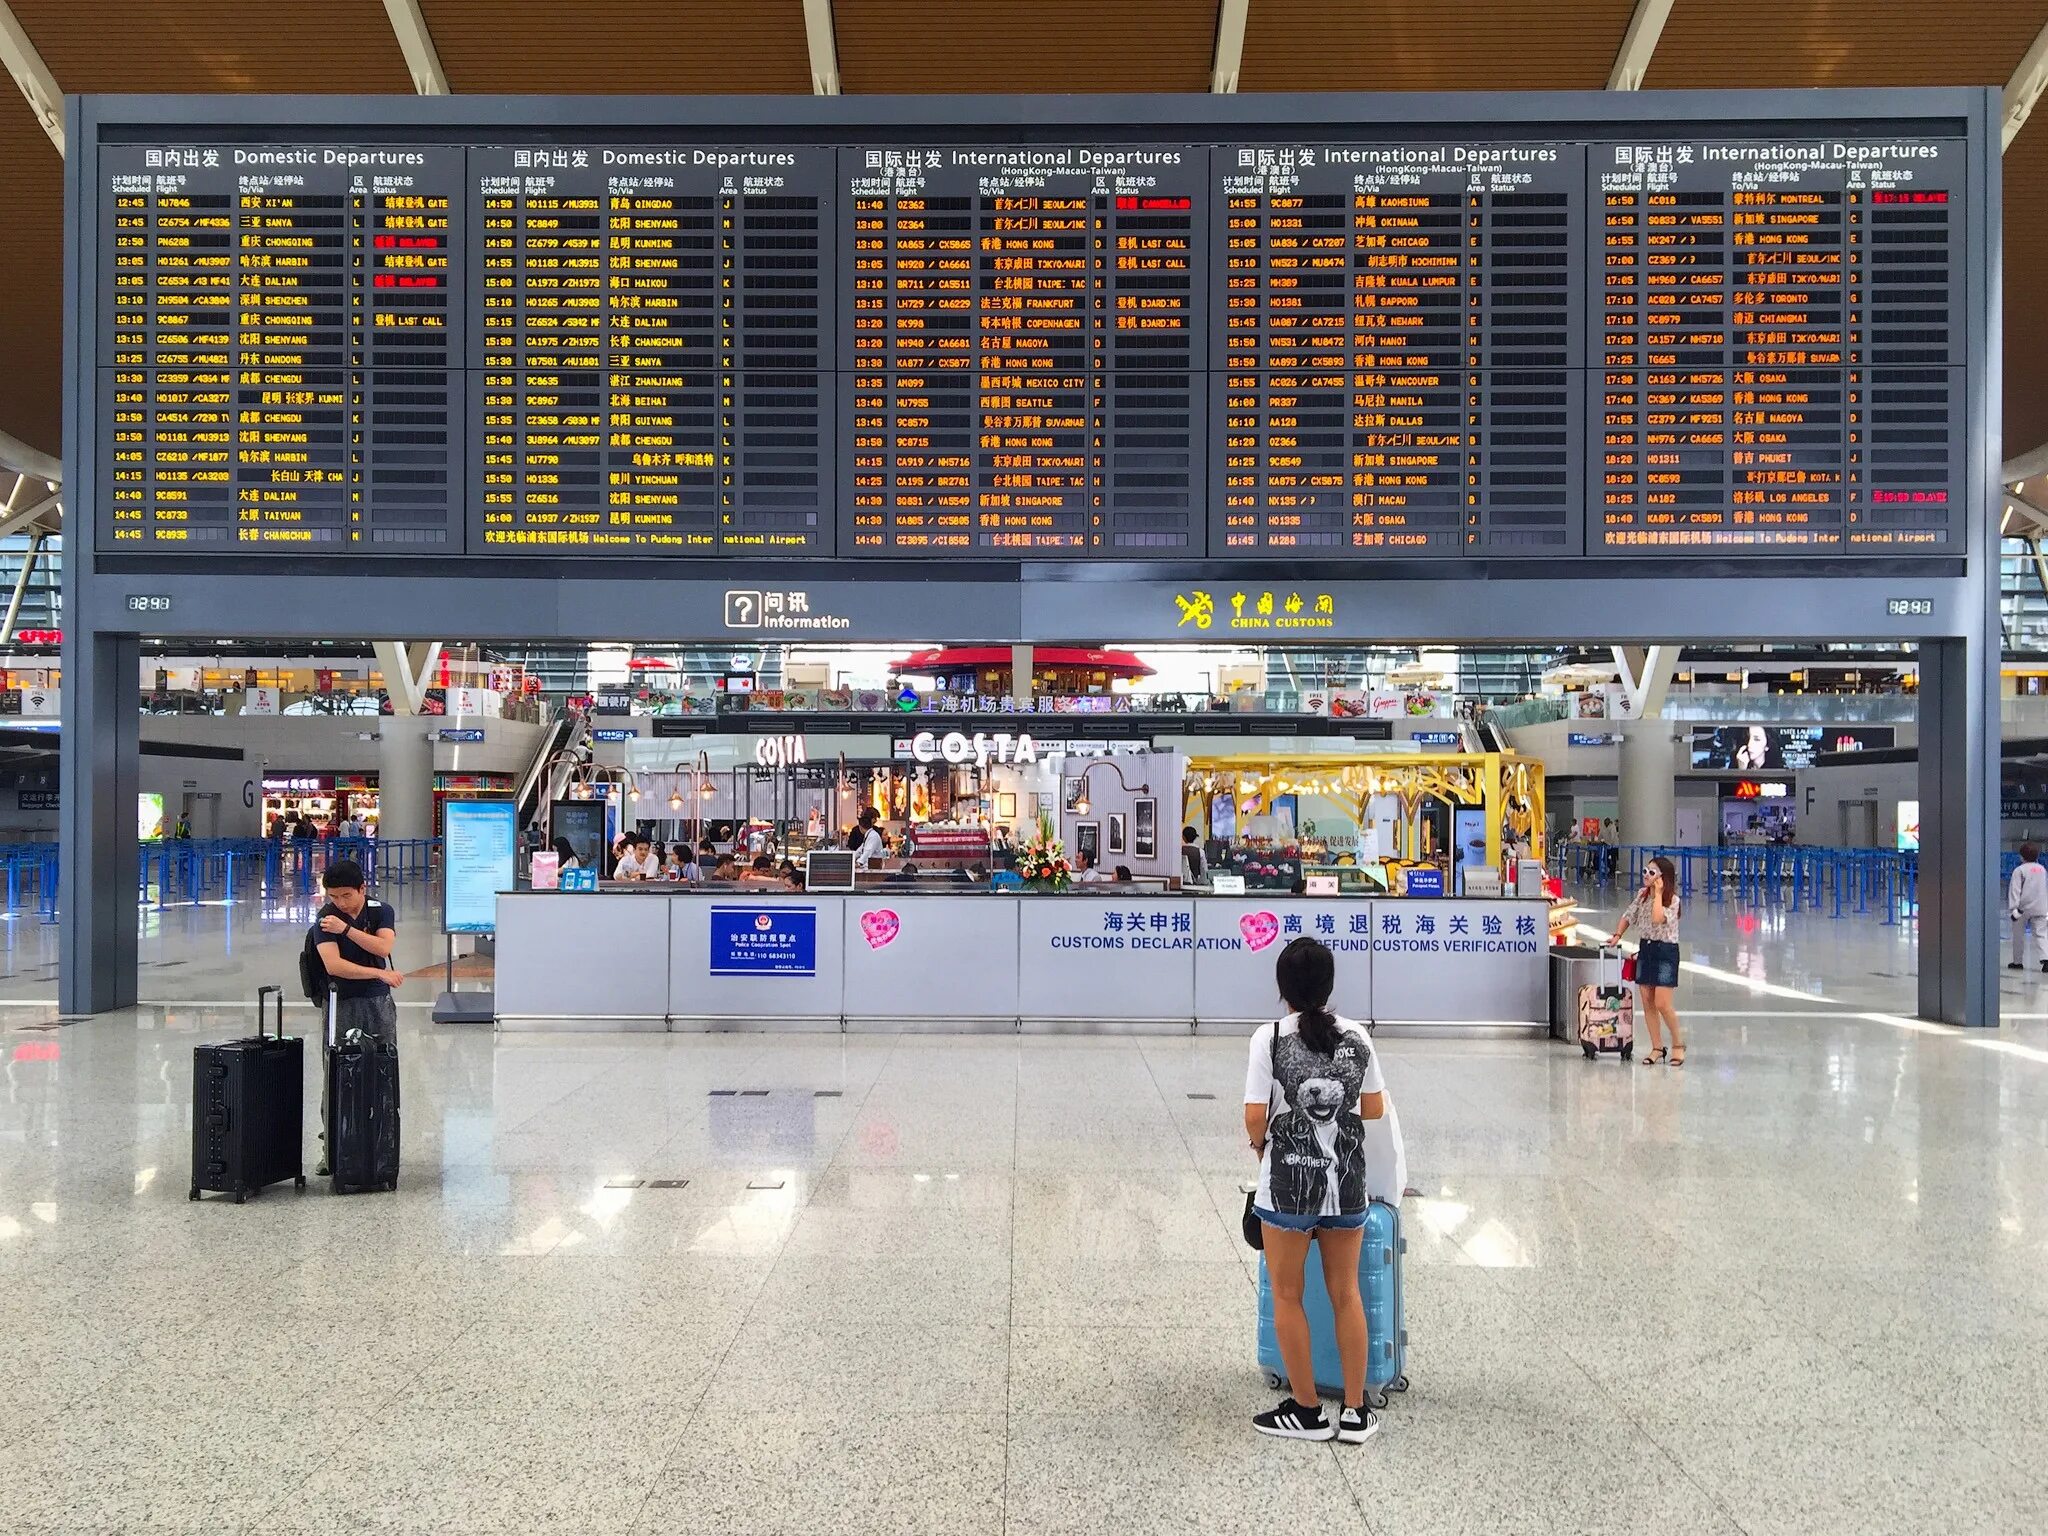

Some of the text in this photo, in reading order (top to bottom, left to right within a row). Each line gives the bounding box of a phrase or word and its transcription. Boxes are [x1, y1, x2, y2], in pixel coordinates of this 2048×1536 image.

[146, 149, 423, 167] 国内出发 Domestic Departures
[515, 150, 794, 168] 国内出发 Domestic Departures
[866, 149, 1180, 169] 国际出发 International Departures
[1239, 147, 1556, 167] 国际出发 International Departures
[1616, 144, 1937, 164] 国际出发 International Departures
[999, 166, 1127, 176] (HongKong-Macau-Taiwan)
[1374, 164, 1504, 174] (HongKong-Macau-Taiwan)
[1752, 160, 1885, 171] (HongKong-Macau-Taiwan)
[111, 175, 152, 186] 计划时间
[156, 175, 186, 186] 航班号
[239, 175, 304, 186] 终点站/经停站
[373, 176, 414, 186] 航班状态
[480, 176, 520, 187] 计划时间
[525, 176, 555, 187] 航班号
[608, 176, 674, 188] 终点站/经停站
[743, 176, 784, 187] 航班状态
[850, 177, 890, 188] 计划时间
[895, 177, 926, 188] 航班号
[979, 177, 1045, 187] 终点站/经停站
[1115, 176, 1156, 187] 航班状态
[1223, 175, 1264, 186] 计划时间
[1269, 175, 1300, 186] 航班号
[1354, 174, 1420, 185] 终点站/经停站
[1491, 173, 1532, 184] 航班状态
[1601, 173, 1642, 183] 计划时间
[1647, 173, 1678, 183] 航班号
[1732, 172, 1799, 183] 终点站/经停站
[1871, 170, 1913, 181] 航班状态
[111, 185, 397, 194] Scheduled Flight To/Via Area Status
[480, 187, 767, 196] Scheduled Flight To/Via Area Status
[851, 186, 1140, 196] Scheduled Flight To/Via Area Status
[1223, 184, 1515, 195] Scheduled Flight To/Via Area Status
[1601, 181, 1896, 192] Scheduled Flight To/Via Area Status
[118, 199, 144, 207] 12:45
[241, 196, 261, 208] 西安
[266, 199, 292, 207] XI'AN
[1607, 196, 1633, 205] 16:50
[1781, 195, 1823, 203] MONTREAL
[486, 219, 512, 228] 14:50
[610, 217, 630, 229] 沈阳
[635, 220, 678, 228] SHENYANG
[1771, 295, 1808, 303] TORONTO
[117, 316, 143, 324] 13:10
[241, 314, 260, 325] 重庆
[265, 316, 312, 325] CHONGQING
[376, 314, 395, 326] 登机
[423, 317, 442, 326] CALL
[857, 319, 883, 328] 13:20
[981, 317, 1021, 329] 哥本哈根
[1027, 320, 1079, 328] COPENHAGEN
[1229, 418, 1255, 427] 16:10
[1354, 414, 1385, 427] 达拉斯
[1390, 417, 1423, 425] DALLAS
[1734, 491, 1829, 503] 洛杉矶 LOS ANGELES
[486, 531, 589, 543] 欢迎光临浦东国际机场
[593, 534, 630, 543] Welcome
[651, 535, 682, 544] Pudong
[688, 535, 713, 543] Inter
[724, 535, 764, 543] national
[770, 535, 805, 544] Airport
[129, 597, 170, 610] 12:41
[765, 592, 809, 613] 问讯
[1889, 600, 1931, 614] 12:41
[765, 615, 850, 628] Information
[1231, 617, 1334, 628] CHINA CUSTOMS
[755, 735, 807, 768] COSTA
[911, 732, 1036, 767] COSTA
[242, 780, 254, 808] G
[1806, 787, 1815, 815] F
[1104, 911, 1191, 933] 海关申报
[1283, 913, 1537, 936] 离境退税海关验核
[1051, 936, 1242, 951] CUSTOMS DECLARATION
[1372, 939, 1440, 953] CUSTOMS
[1443, 939, 1538, 953] VERIFICATION
